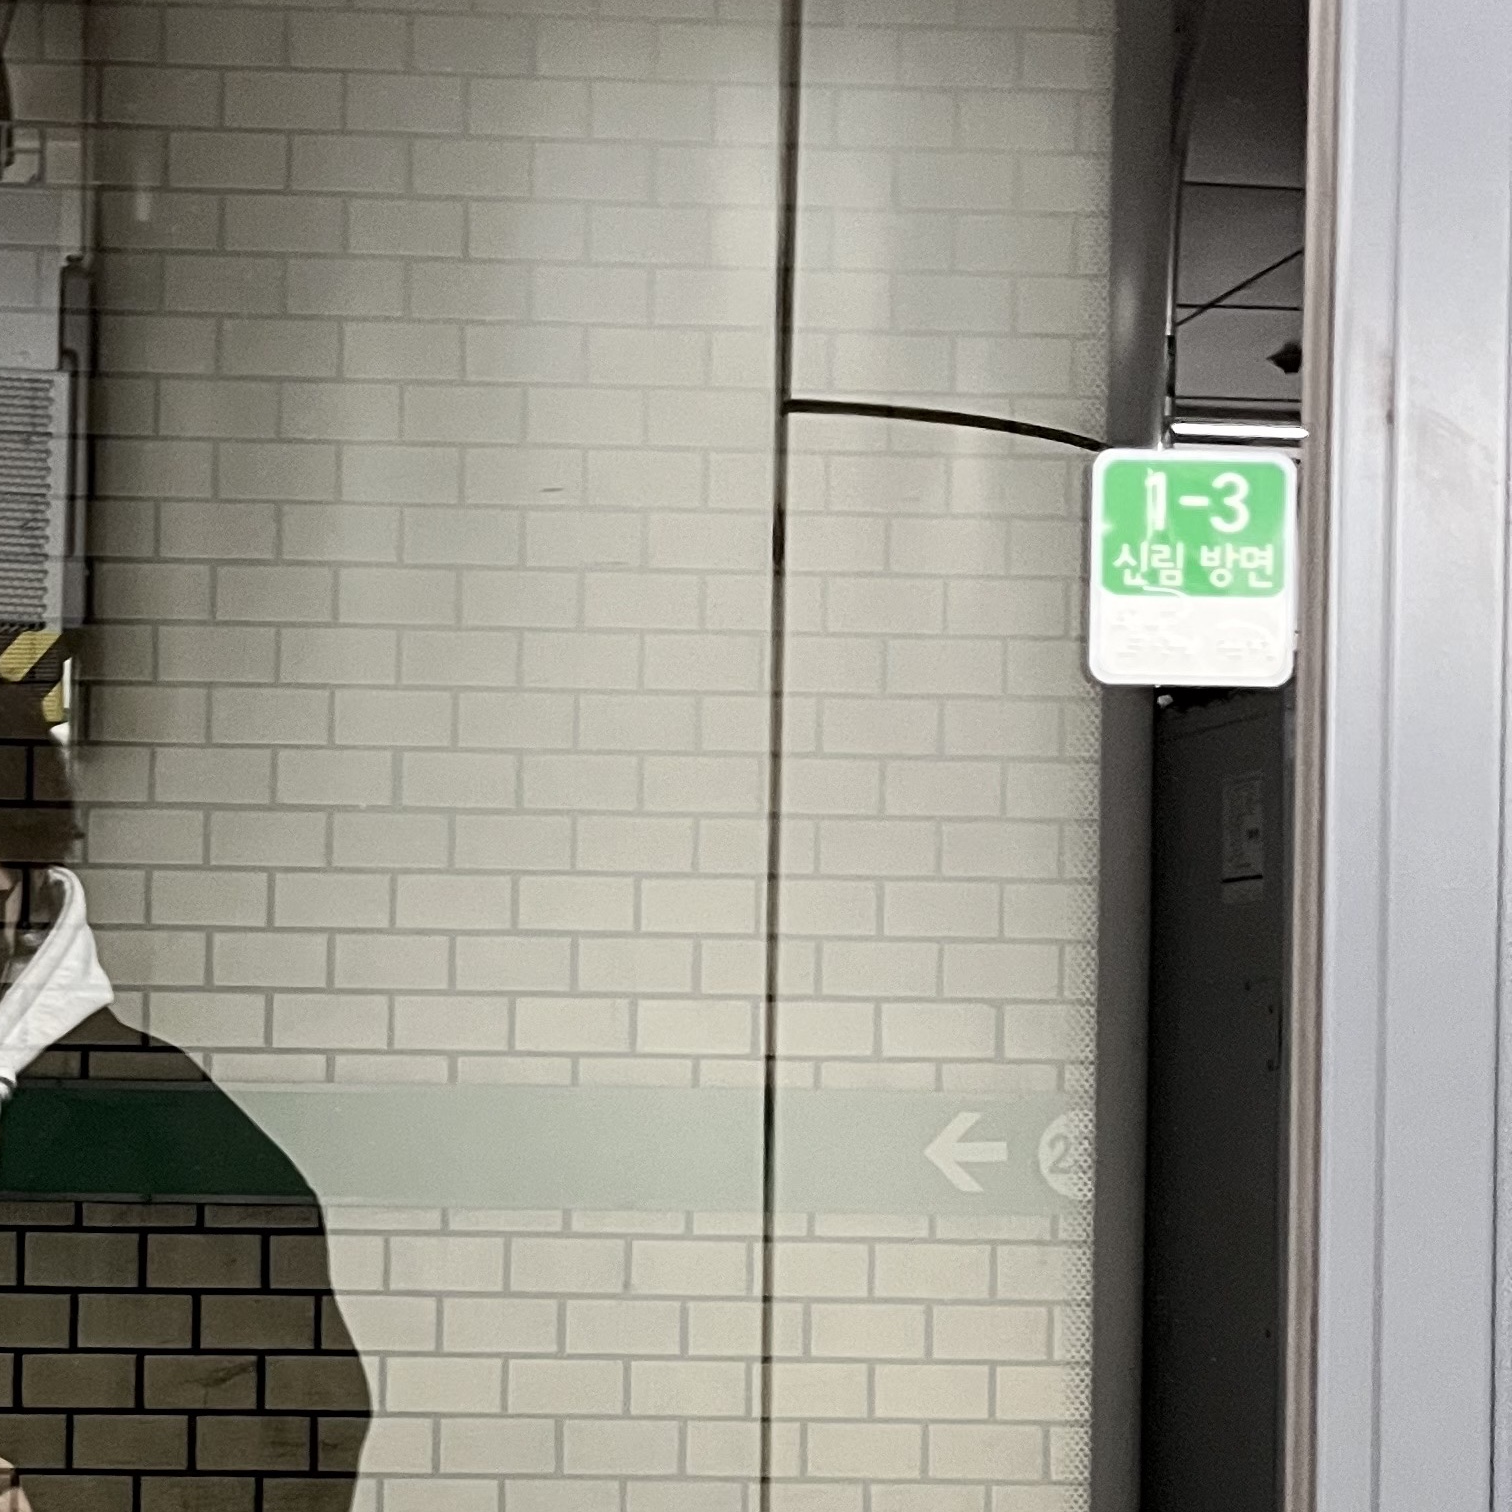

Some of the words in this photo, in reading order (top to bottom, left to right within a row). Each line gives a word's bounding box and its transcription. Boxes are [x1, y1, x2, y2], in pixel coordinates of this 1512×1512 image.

[1144, 471, 1250, 533] 1-3
[1113, 541, 1185, 587] 신림
[1199, 542, 1274, 588] 방면
